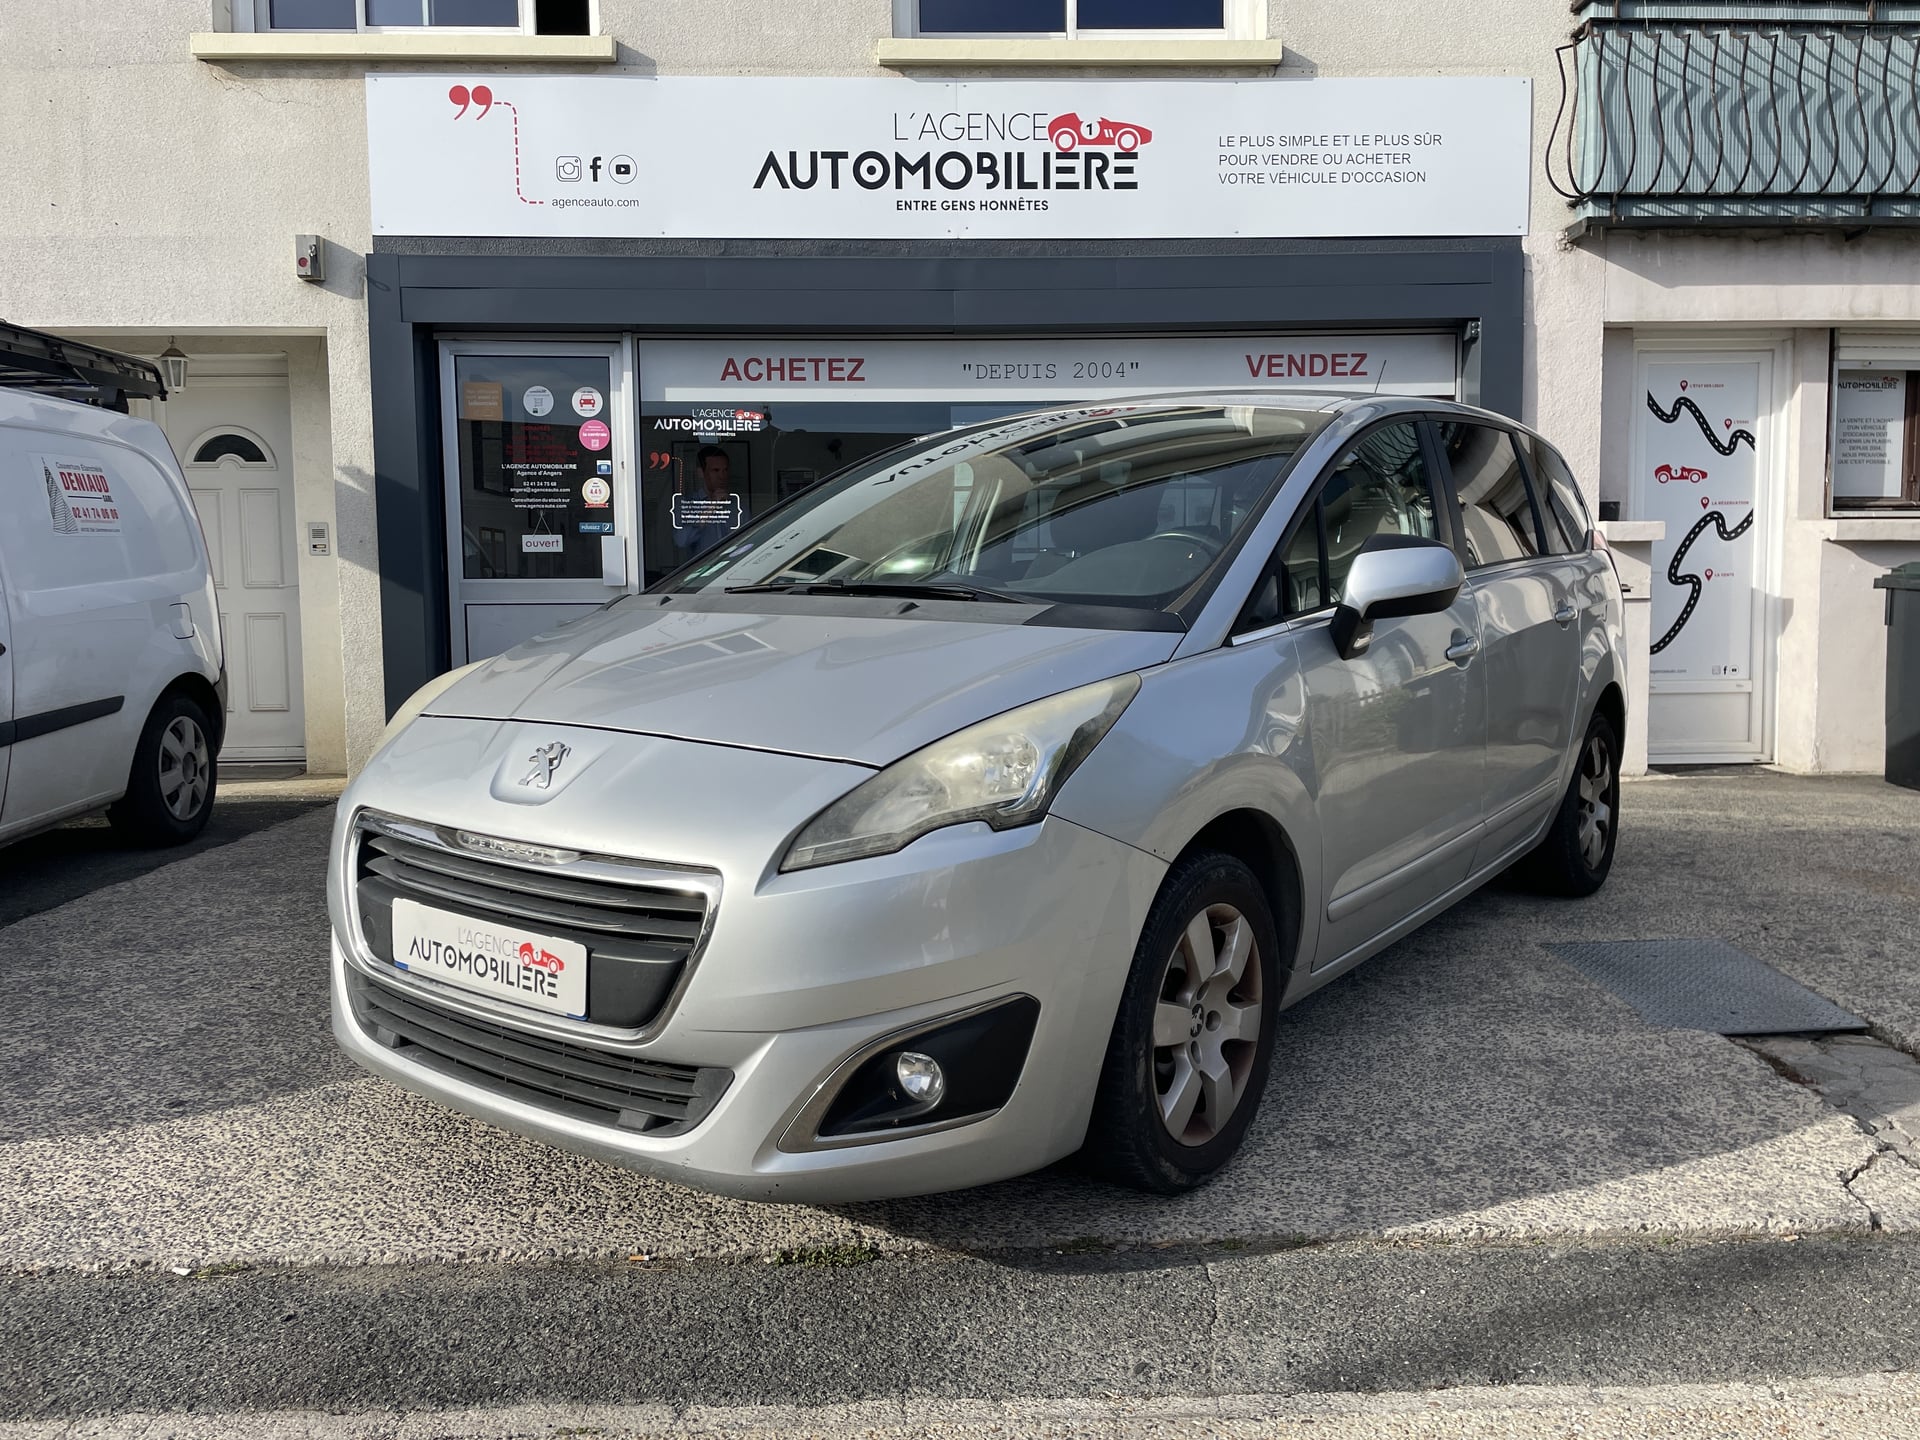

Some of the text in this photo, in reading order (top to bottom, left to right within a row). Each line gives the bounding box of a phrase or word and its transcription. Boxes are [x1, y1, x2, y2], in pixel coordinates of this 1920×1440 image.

[894, 112, 1048, 142] L'AGENCE
[1219, 131, 1442, 148] LE PLUS SIMPLE ET LE PLUS SÛR
[1219, 153, 1411, 166] POUR VENDRE OU ACHETER
[1219, 169, 1425, 184] VOTRE VÉHICULE D'OCCASION
[551, 197, 640, 209] agenceauto.com
[896, 197, 1049, 211] ENTRE GENS HONNÊTES
[720, 357, 866, 383] ACHETEZ
[963, 361, 1139, 380] "DEPUIS 2004"
[1246, 352, 1368, 378] VENDEZ
[692, 409, 735, 418] L'AGENCE
[59, 471, 109, 493] DENIAUD
[525, 538, 560, 548] ouvert
[457, 927, 521, 960] L'AGENCE
